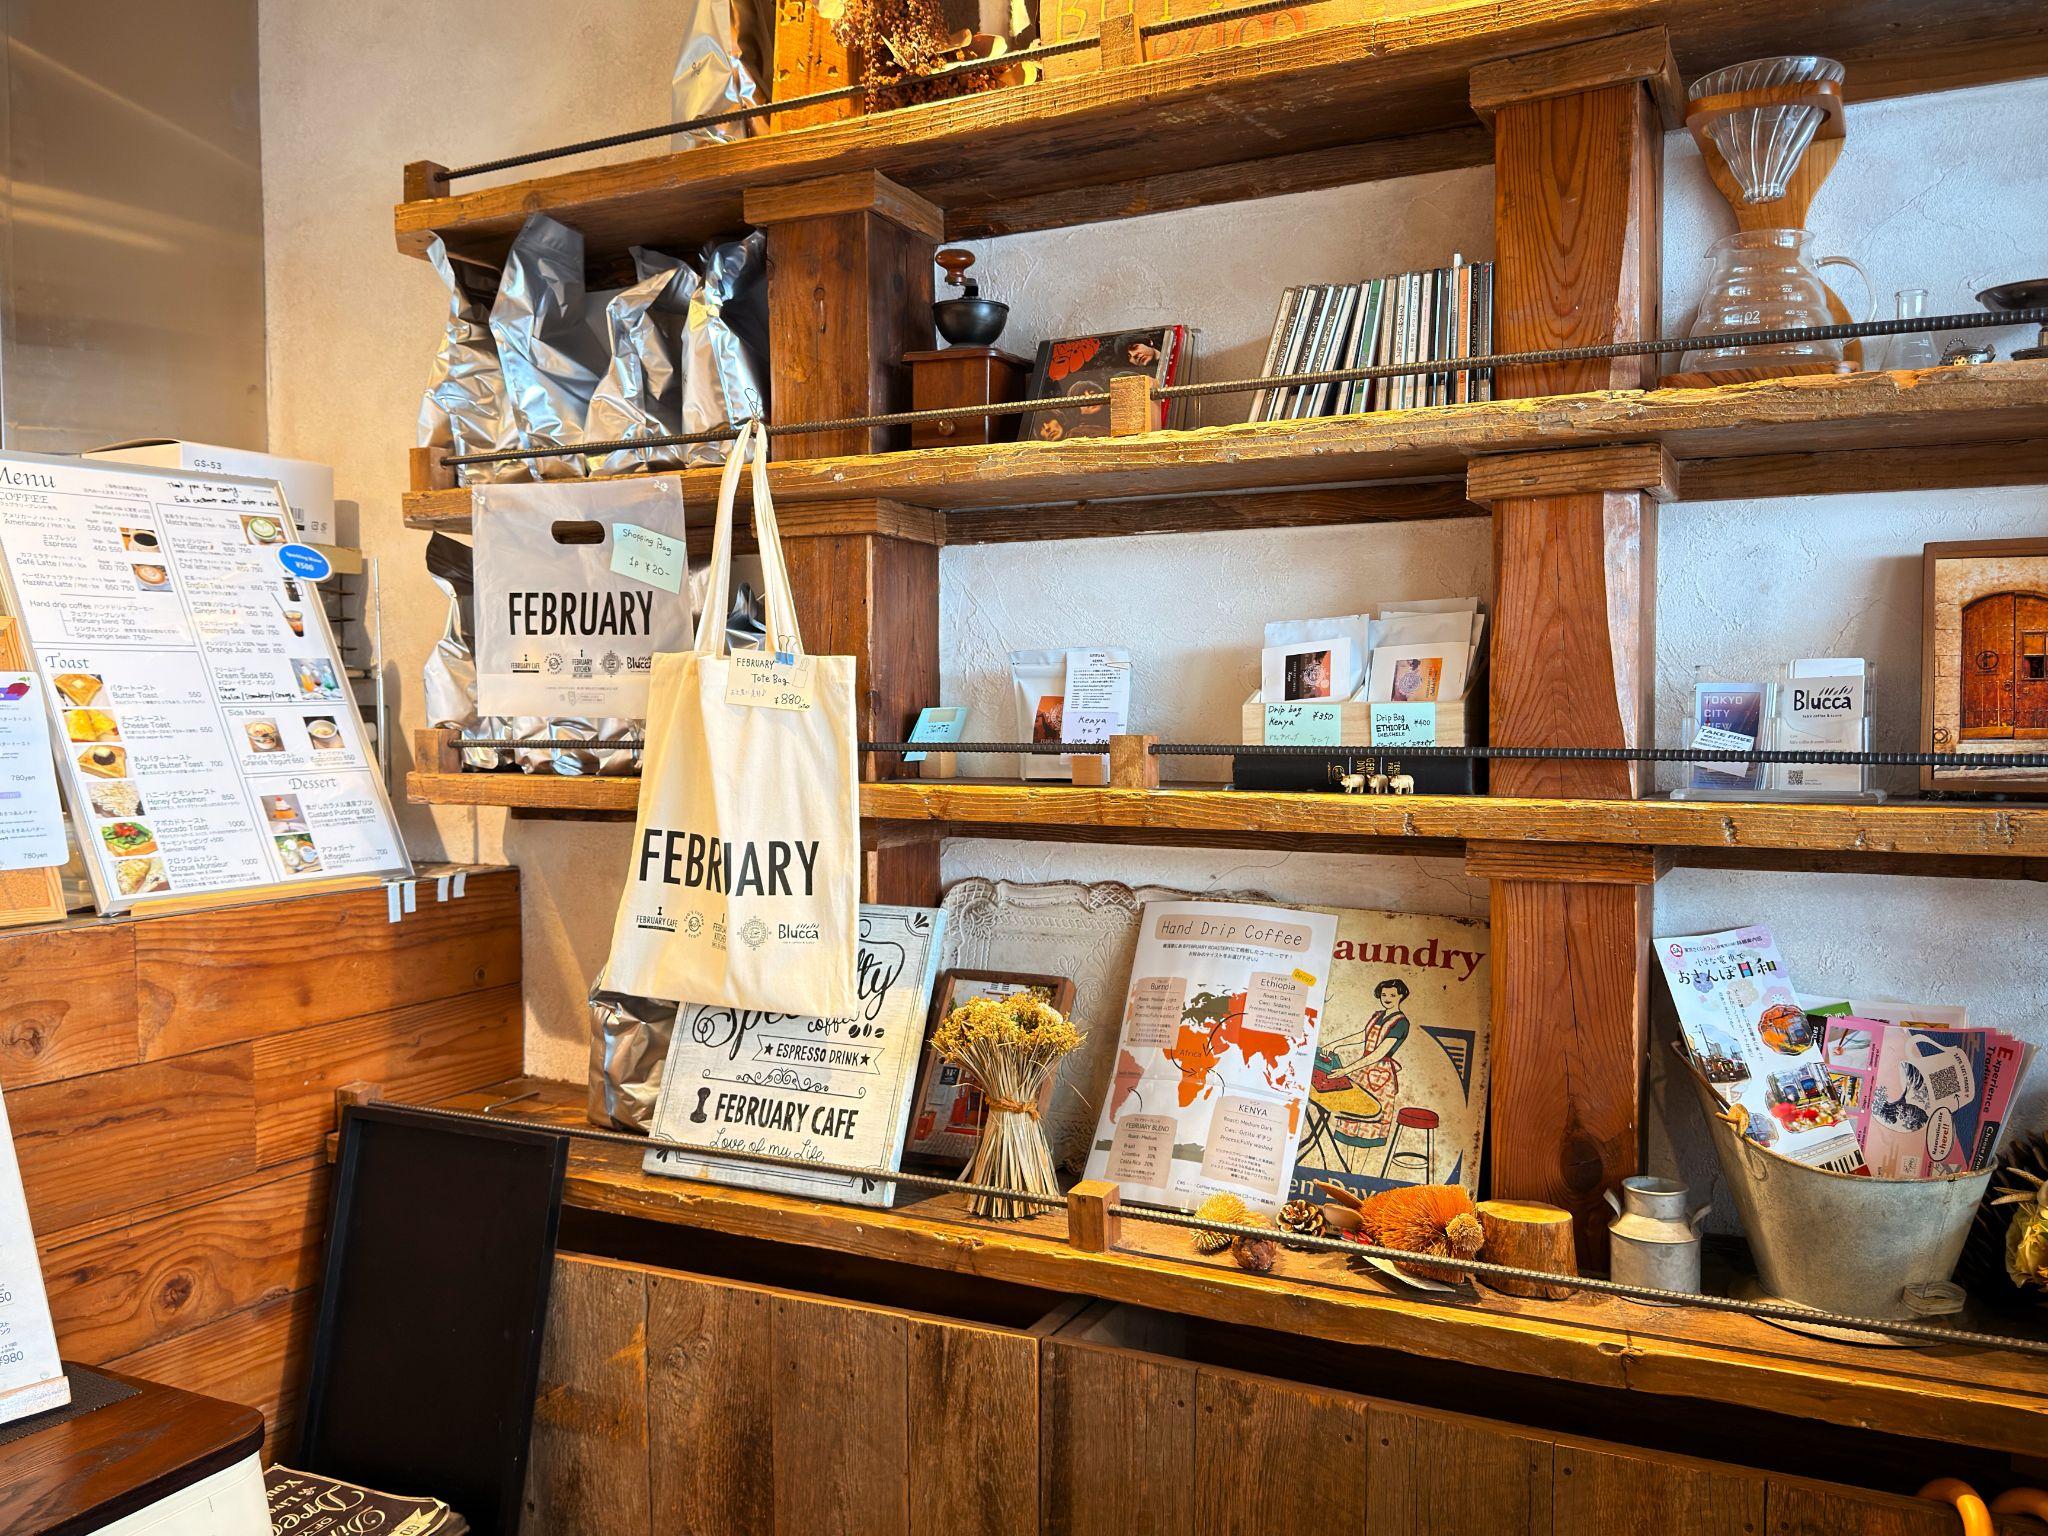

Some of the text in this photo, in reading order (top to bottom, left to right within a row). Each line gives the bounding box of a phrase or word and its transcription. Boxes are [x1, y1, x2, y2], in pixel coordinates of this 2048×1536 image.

[1744, 311, 1760, 320] 02
[194, 460, 222, 470] GS-53
[623, 528, 672, 557] Shopping Bag
[509, 590, 654, 636] FEBRUARY
[45, 652, 89, 669] Toast
[736, 657, 776, 670] FEBRUARY
[751, 673, 790, 686] Tote Bag
[1704, 695, 1743, 705] TOKYO
[1793, 687, 1852, 711] Blucca
[1268, 705, 1286, 715] Drip
[1704, 709, 1730, 718] CITY
[1079, 715, 1107, 727] Kenya
[1268, 717, 1295, 730] Kenya
[1376, 713, 1405, 724] Drip Bag
[1376, 724, 1410, 732] ETHIOPIA
[1701, 728, 1727, 738] TAKE
[288, 777, 337, 790] Dessert
[636, 915, 667, 926] FEBRUARY
[778, 923, 819, 940] Blucca
[1161, 921, 1303, 946] Hand Drip Coffee
[1333, 938, 1486, 982] aundry
[1260, 978, 1296, 992] Ethiopia
[775, 1042, 860, 1067] ESPRESSO DRINK
[1983, 1045, 2014, 1114] Experience
[714, 1092, 860, 1140] FEBRUARY CAFE
[1238, 1104, 1268, 1117] KENYA
[709, 1127, 747, 1153] Love
[748, 1139, 766, 1155] of
[794, 1144, 825, 1163] Life
